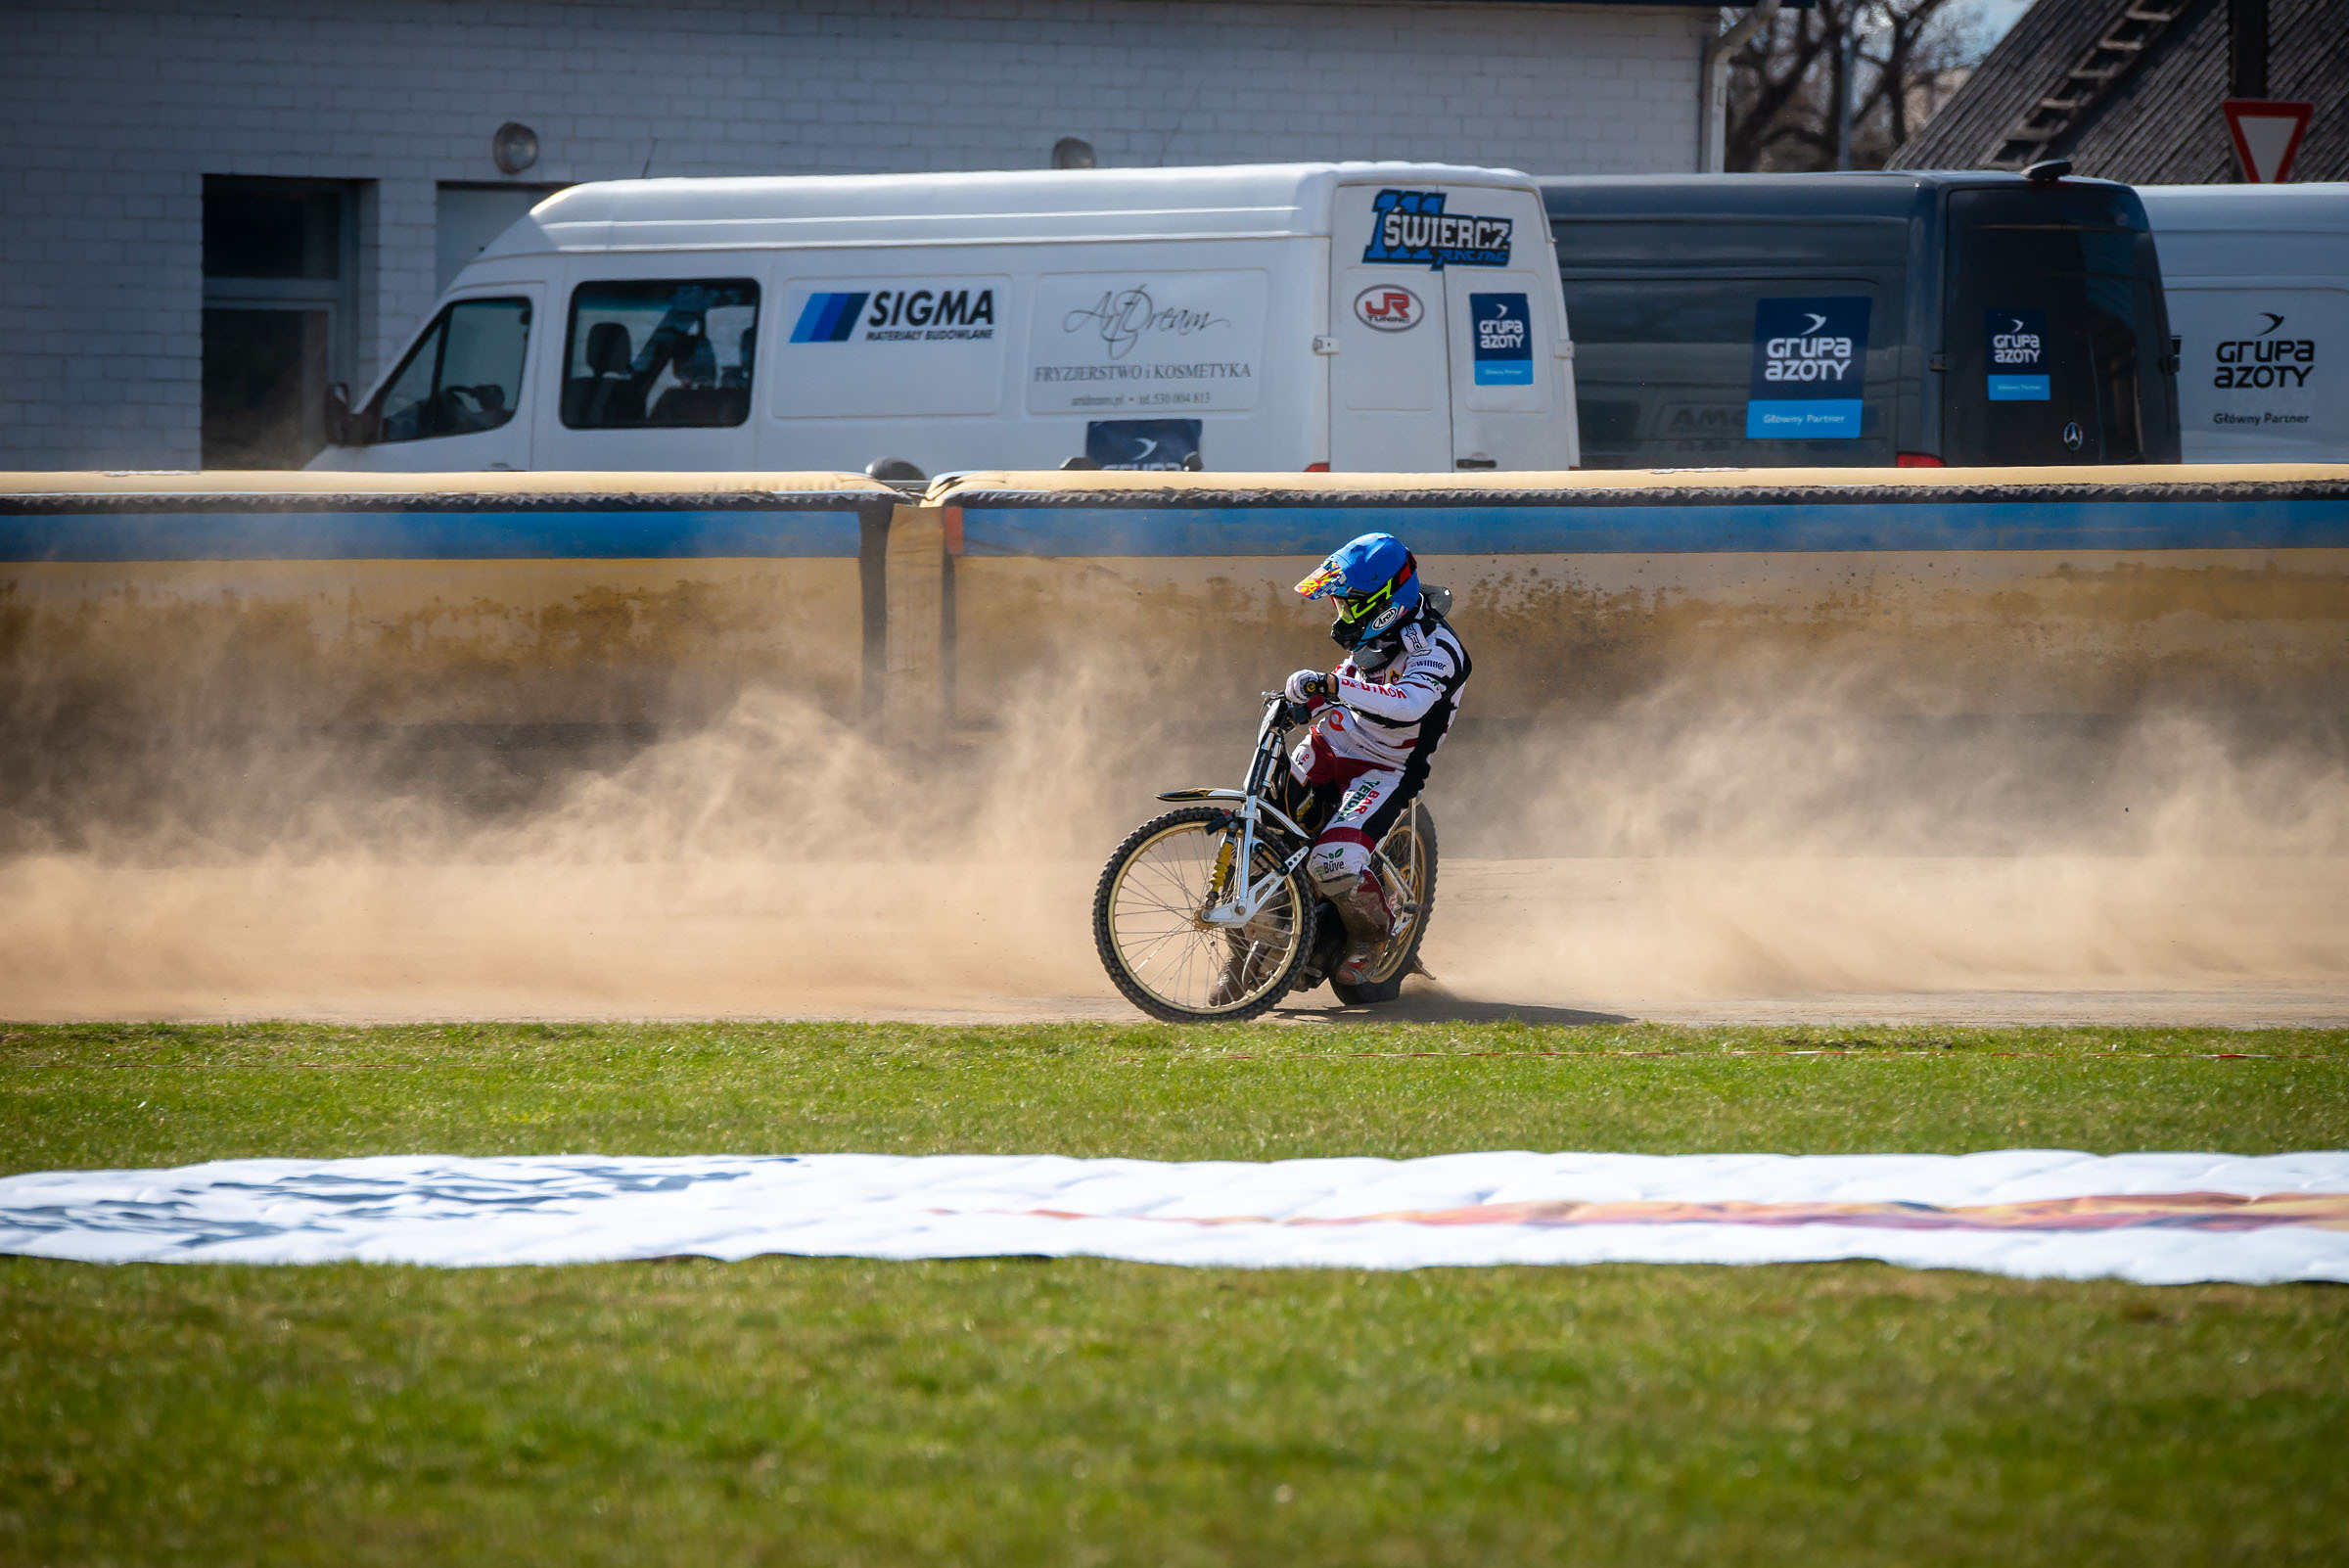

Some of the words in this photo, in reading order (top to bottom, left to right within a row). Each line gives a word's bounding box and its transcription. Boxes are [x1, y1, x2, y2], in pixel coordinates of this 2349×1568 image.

[1383, 207, 1511, 250] ŚWIERCZ
[868, 290, 993, 327] SIGMA
[1365, 293, 1410, 317] JR
[1034, 365, 1143, 382] FRYZJERSTWO
[1154, 363, 1252, 379] KOSMETYKA
[2214, 413, 2261, 426] Główny
[2264, 412, 2310, 424] Partner
[1355, 790, 1381, 814] BAR
